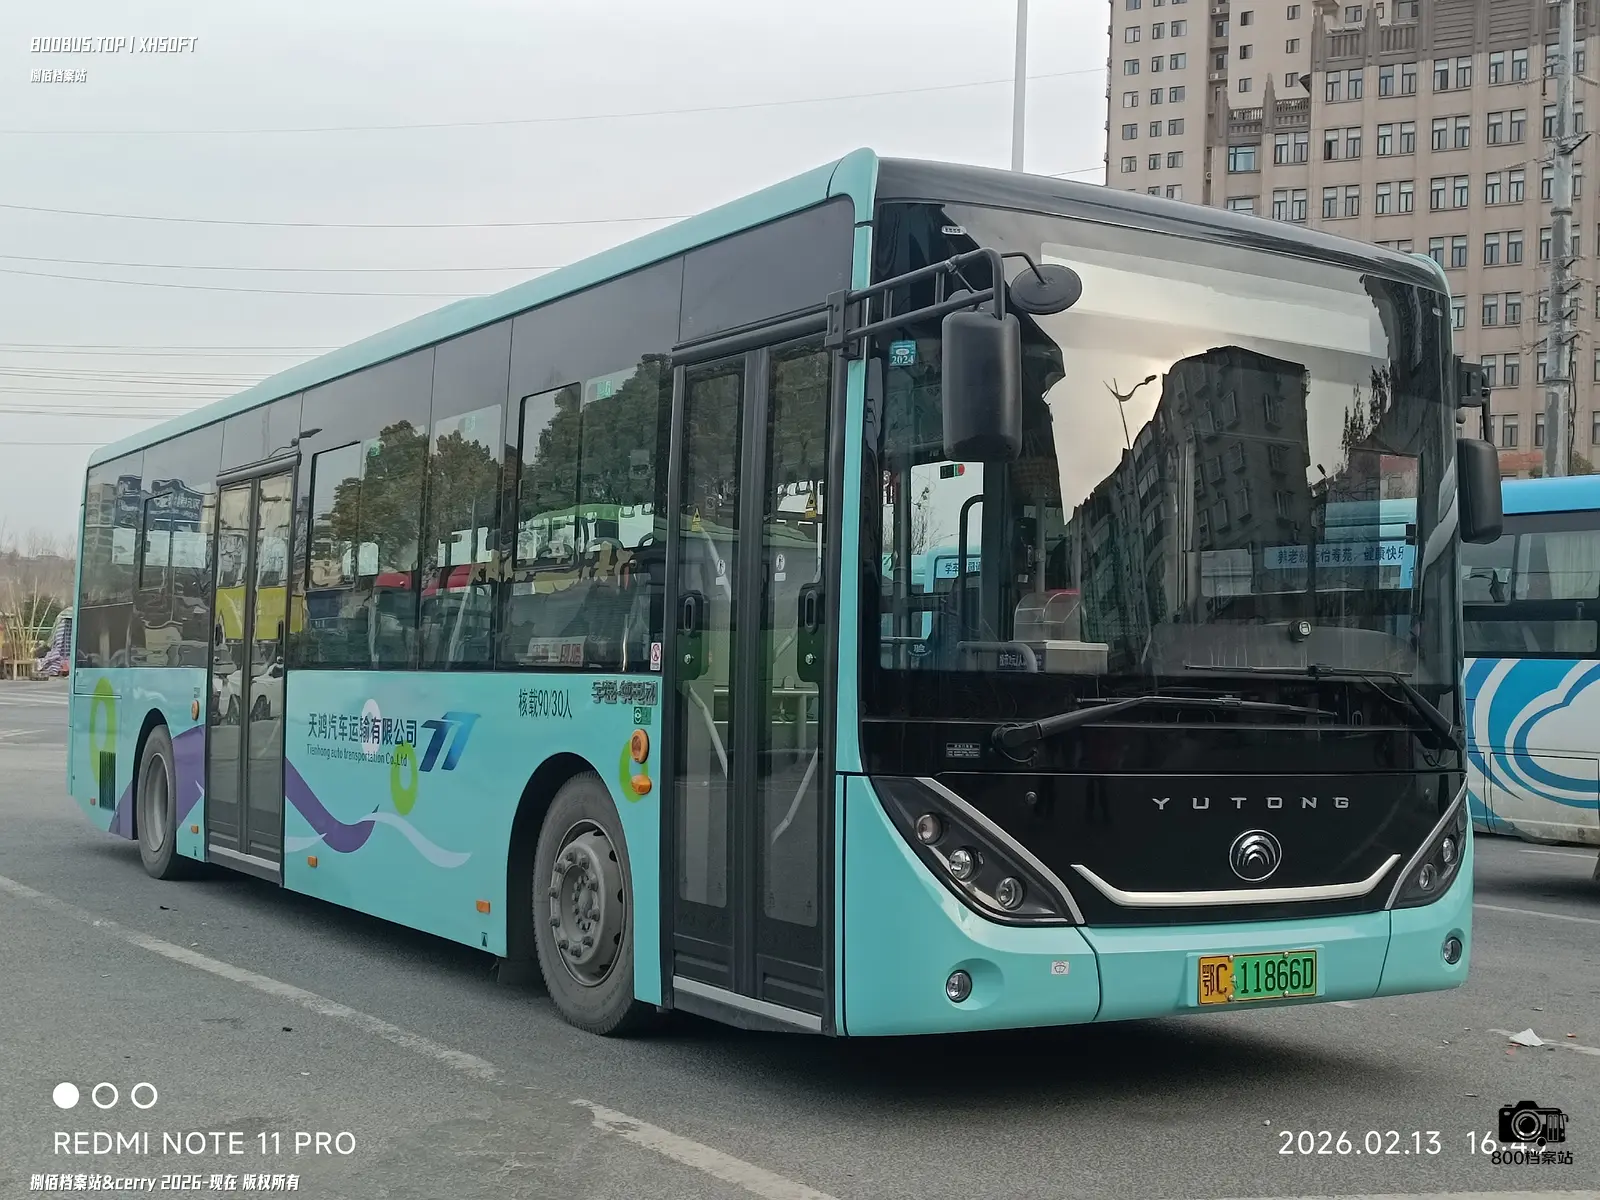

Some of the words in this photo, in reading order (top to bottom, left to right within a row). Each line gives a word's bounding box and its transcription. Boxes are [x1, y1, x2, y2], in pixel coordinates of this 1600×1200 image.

[891, 355, 915, 365] 2024
[308, 713, 417, 748] 天鸿汽车运输有限公司
[331, 747, 344, 759] auto
[1151, 796, 1350, 810] YUTONG
